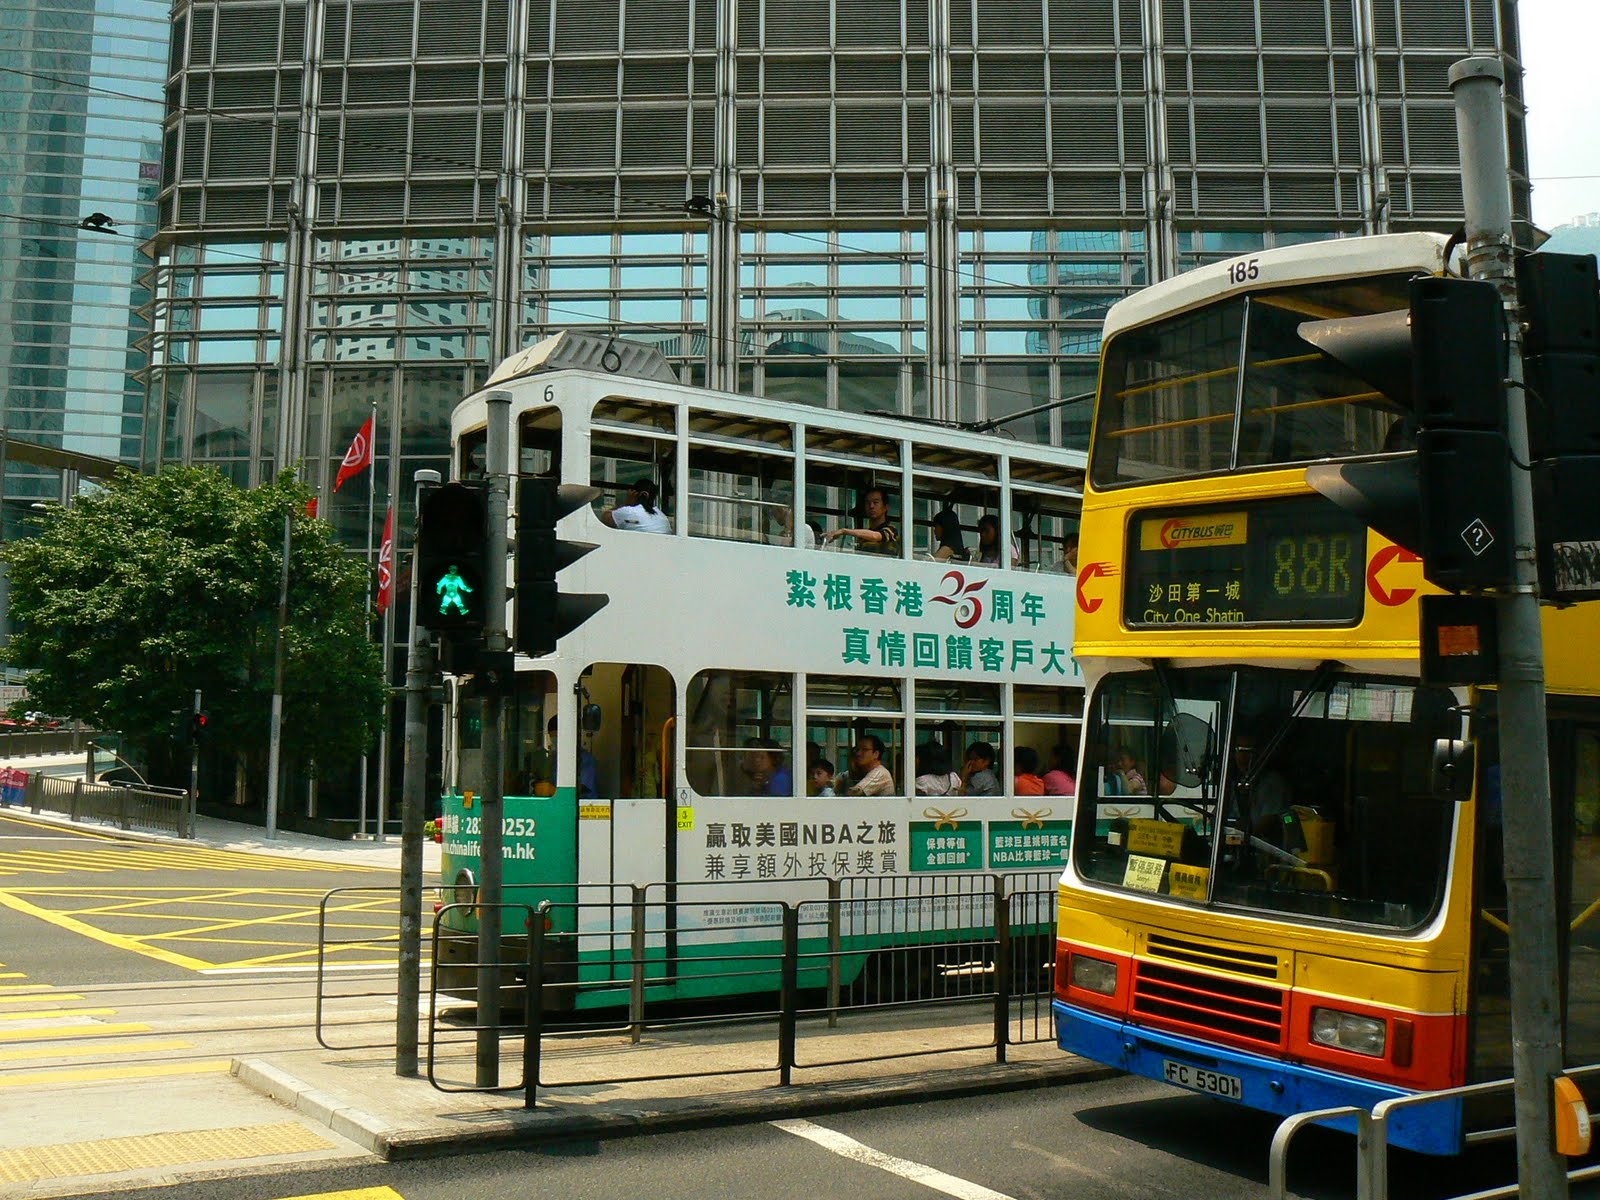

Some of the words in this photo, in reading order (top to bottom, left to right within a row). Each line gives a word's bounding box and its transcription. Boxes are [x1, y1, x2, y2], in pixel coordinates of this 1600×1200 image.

[1227, 258, 1259, 284] 185
[601, 337, 622, 373] 6
[543, 384, 554, 402] 6
[1171, 525, 1214, 539] CITYBUS
[1272, 535, 1351, 595] 88R
[1149, 581, 1241, 603] 沙田第一城
[1143, 608, 1169, 623] City
[1174, 608, 1201, 622] One
[1206, 607, 1244, 622] Shatin
[706, 820, 896, 848] 贏取美國NBA之旅
[926, 837, 966, 850] 保費等值
[704, 849, 898, 880] 兼享額外投保獎賞
[1168, 1062, 1188, 1084] FC
[1196, 1070, 1236, 1097] 5301
